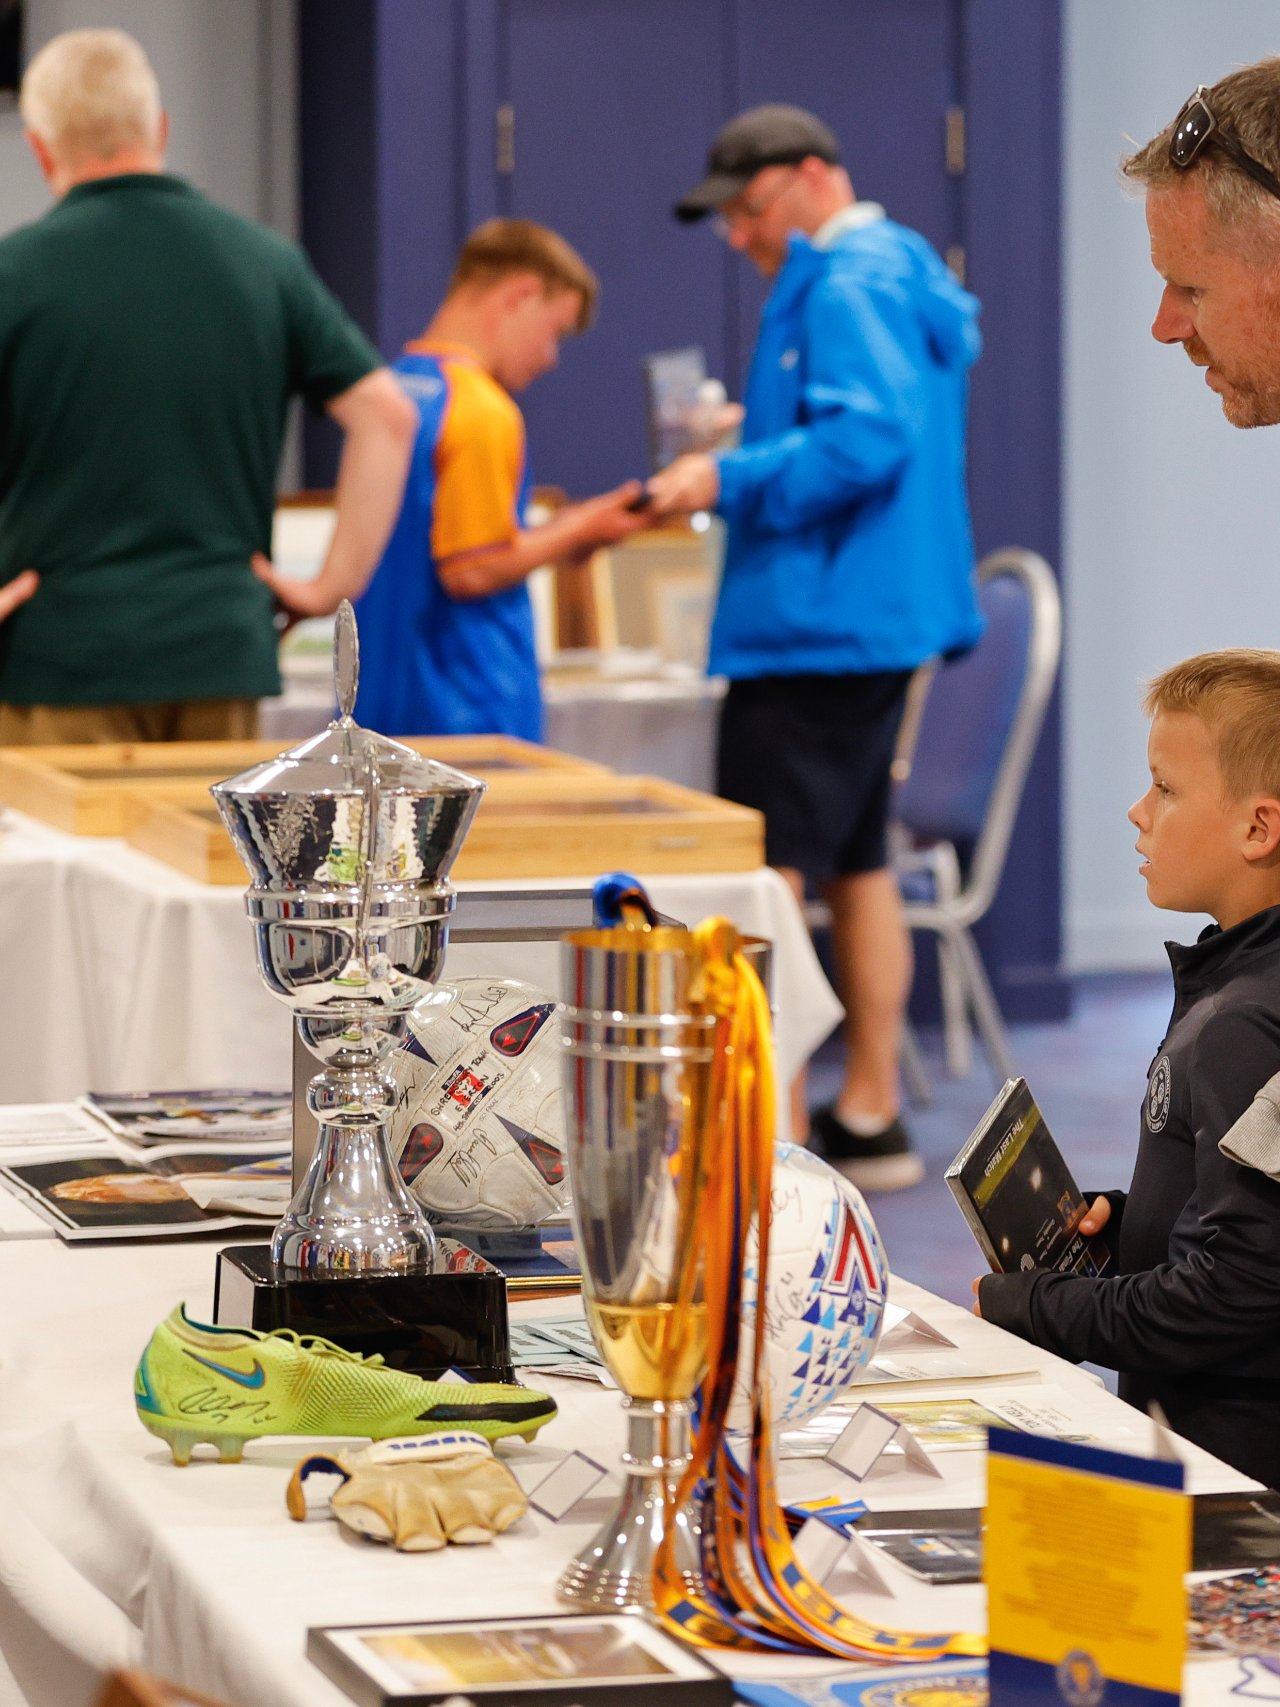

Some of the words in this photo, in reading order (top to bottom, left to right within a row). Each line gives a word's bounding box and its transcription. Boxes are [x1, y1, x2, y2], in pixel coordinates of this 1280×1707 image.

[487, 1072, 505, 1090] 2003
[455, 1074, 490, 1112] EVERTON
[1012, 1118, 1025, 1135] The
[1000, 1132, 1014, 1155] Last
[984, 1150, 1002, 1177] Match
[1072, 1237, 1083, 1254] The
